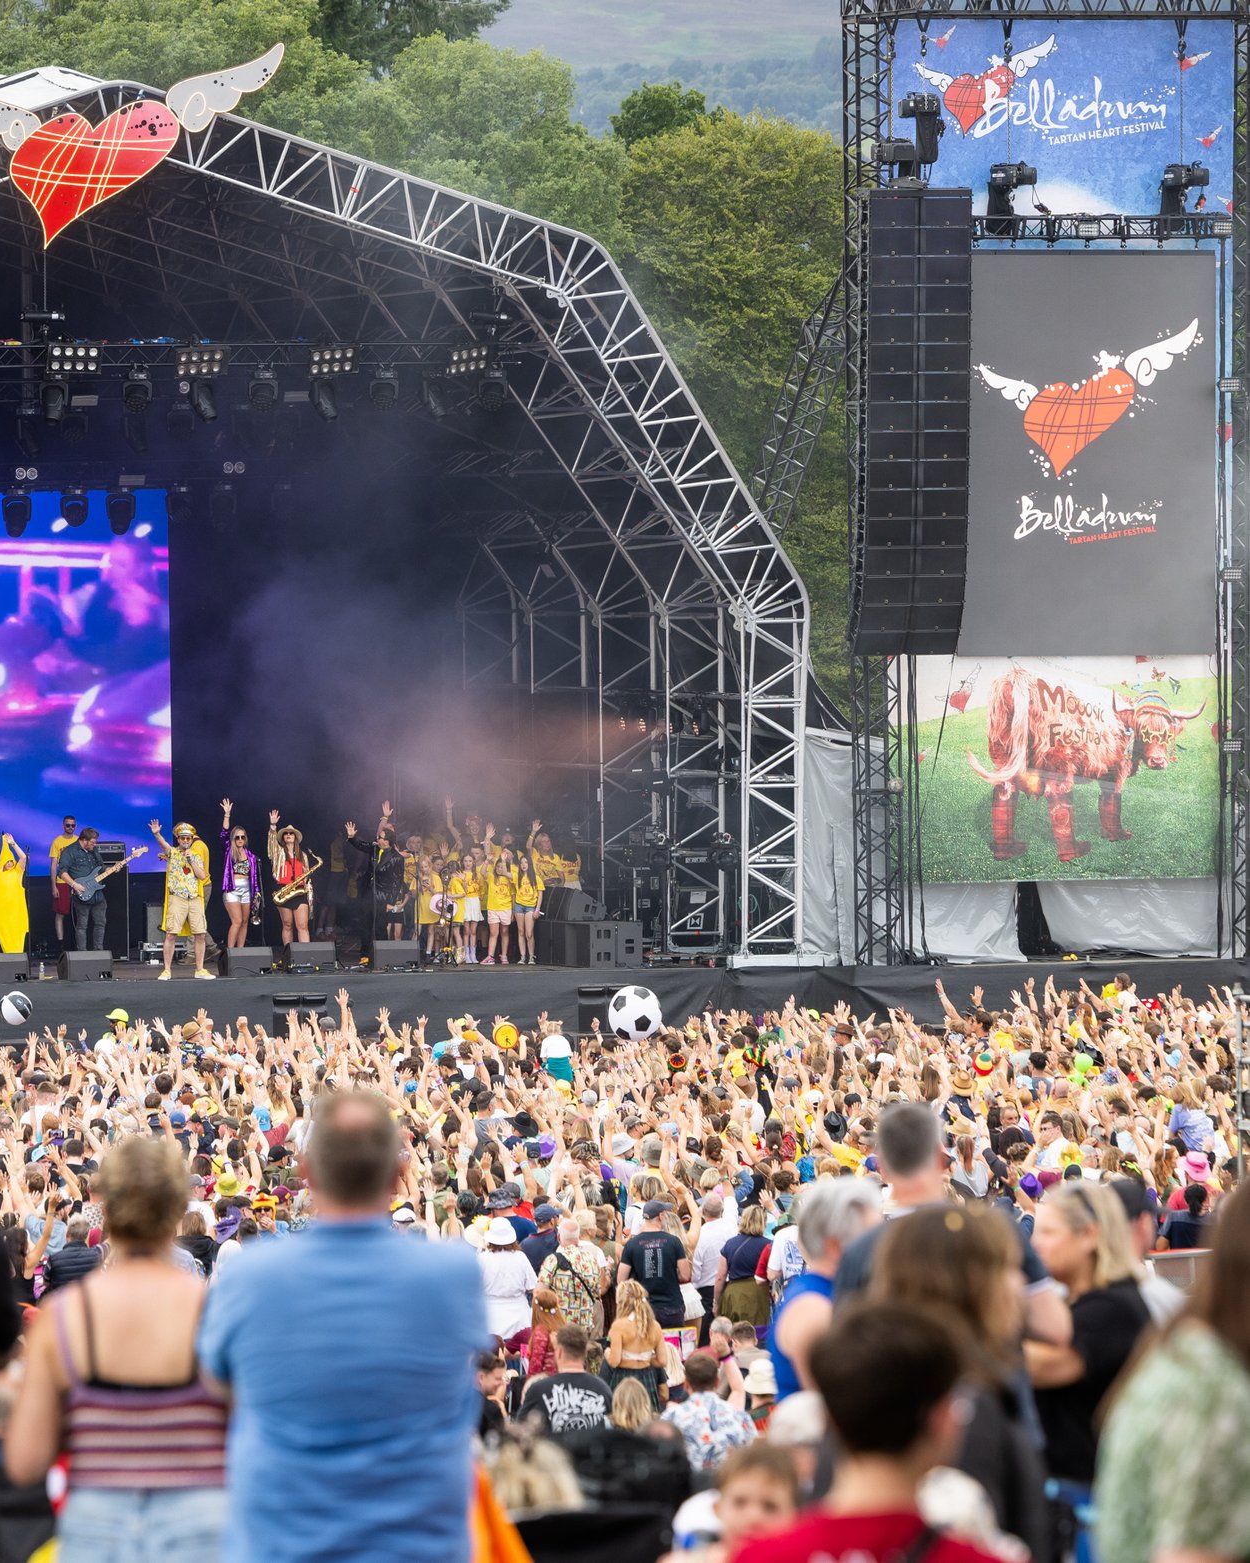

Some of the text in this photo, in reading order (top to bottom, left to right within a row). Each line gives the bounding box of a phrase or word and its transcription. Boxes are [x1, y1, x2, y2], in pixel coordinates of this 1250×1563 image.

[1048, 121, 1167, 146] TARTAN HEART FESTIVAL
[1069, 525, 1157, 545] TARTAN HEART FESTIVAL
